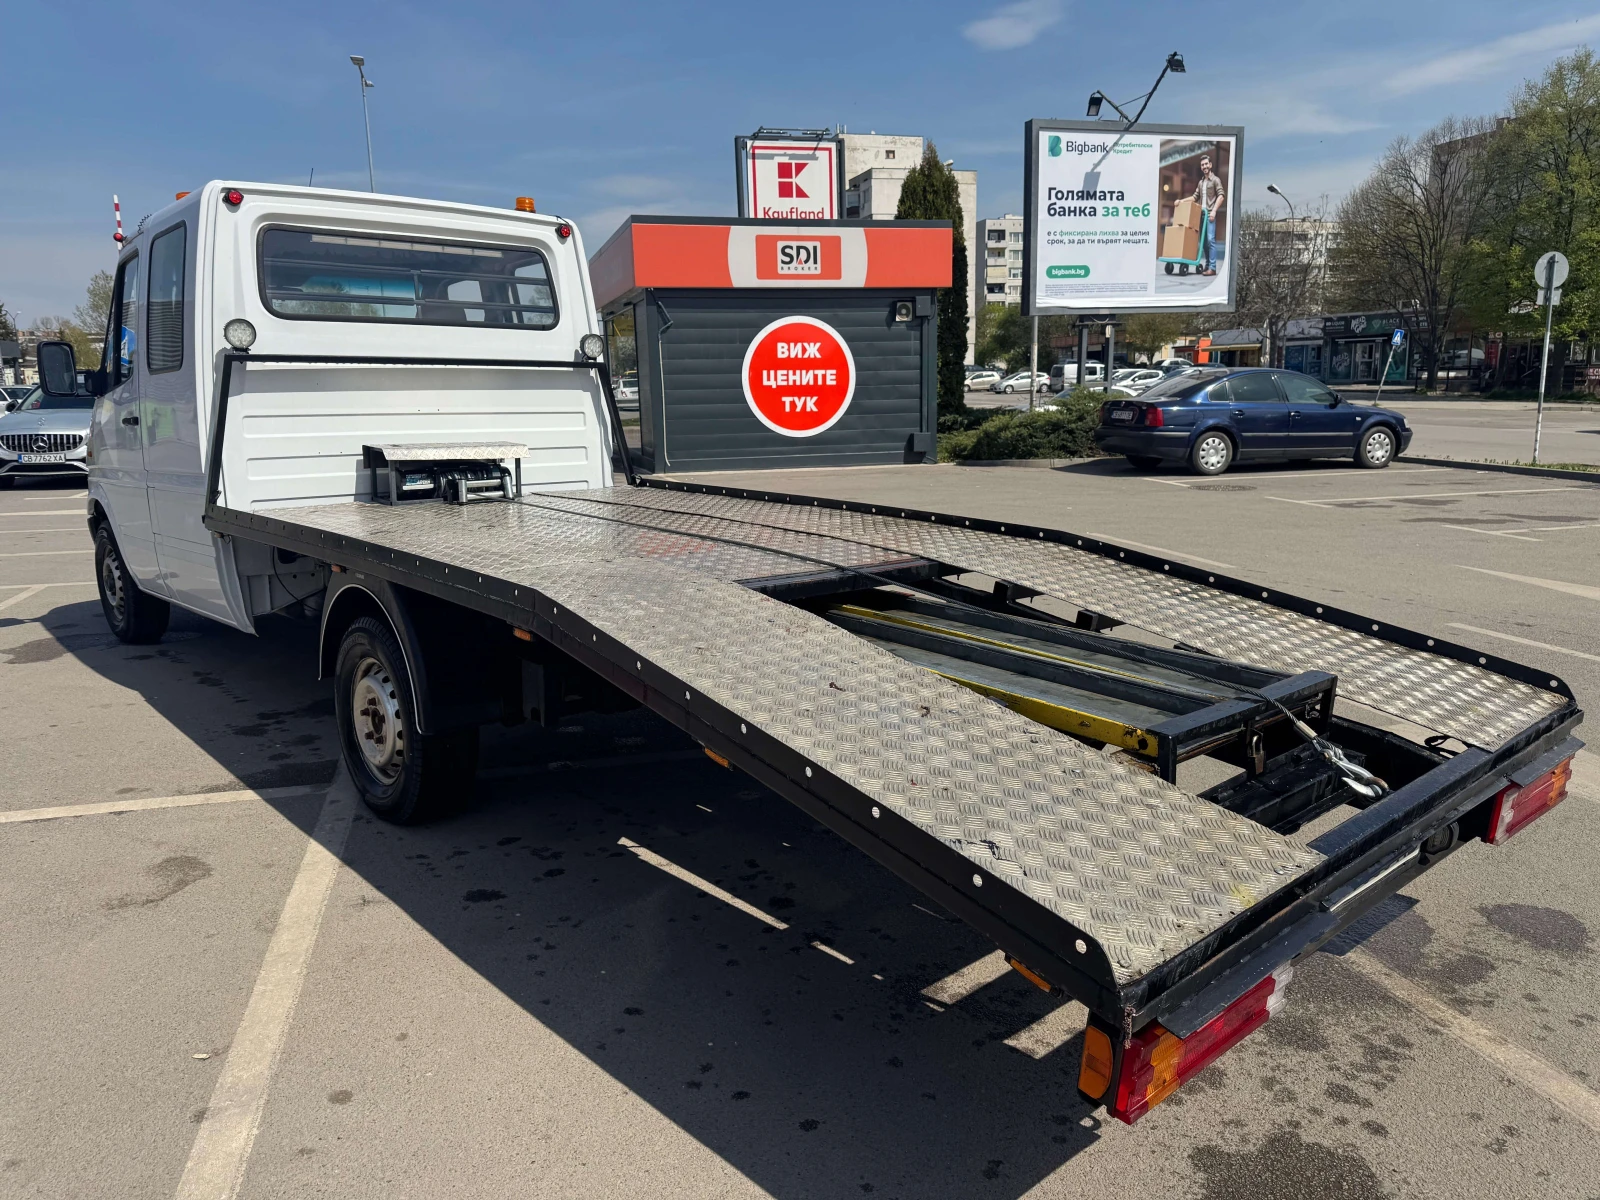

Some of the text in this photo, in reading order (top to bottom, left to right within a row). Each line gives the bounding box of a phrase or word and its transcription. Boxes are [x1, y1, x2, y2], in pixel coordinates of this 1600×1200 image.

[1066, 141, 1109, 156] Bigbank
[1048, 187, 1125, 201] Голямата
[763, 207, 825, 219] Kaufland
[1047, 202, 1151, 217] банка за теб
[780, 245, 818, 265] SDI
[1051, 268, 1085, 276] bigbank.bg
[777, 342, 822, 359] ВИЖ
[762, 369, 837, 389] ЦЕНИТЕ
[781, 396, 819, 412] ТУК
